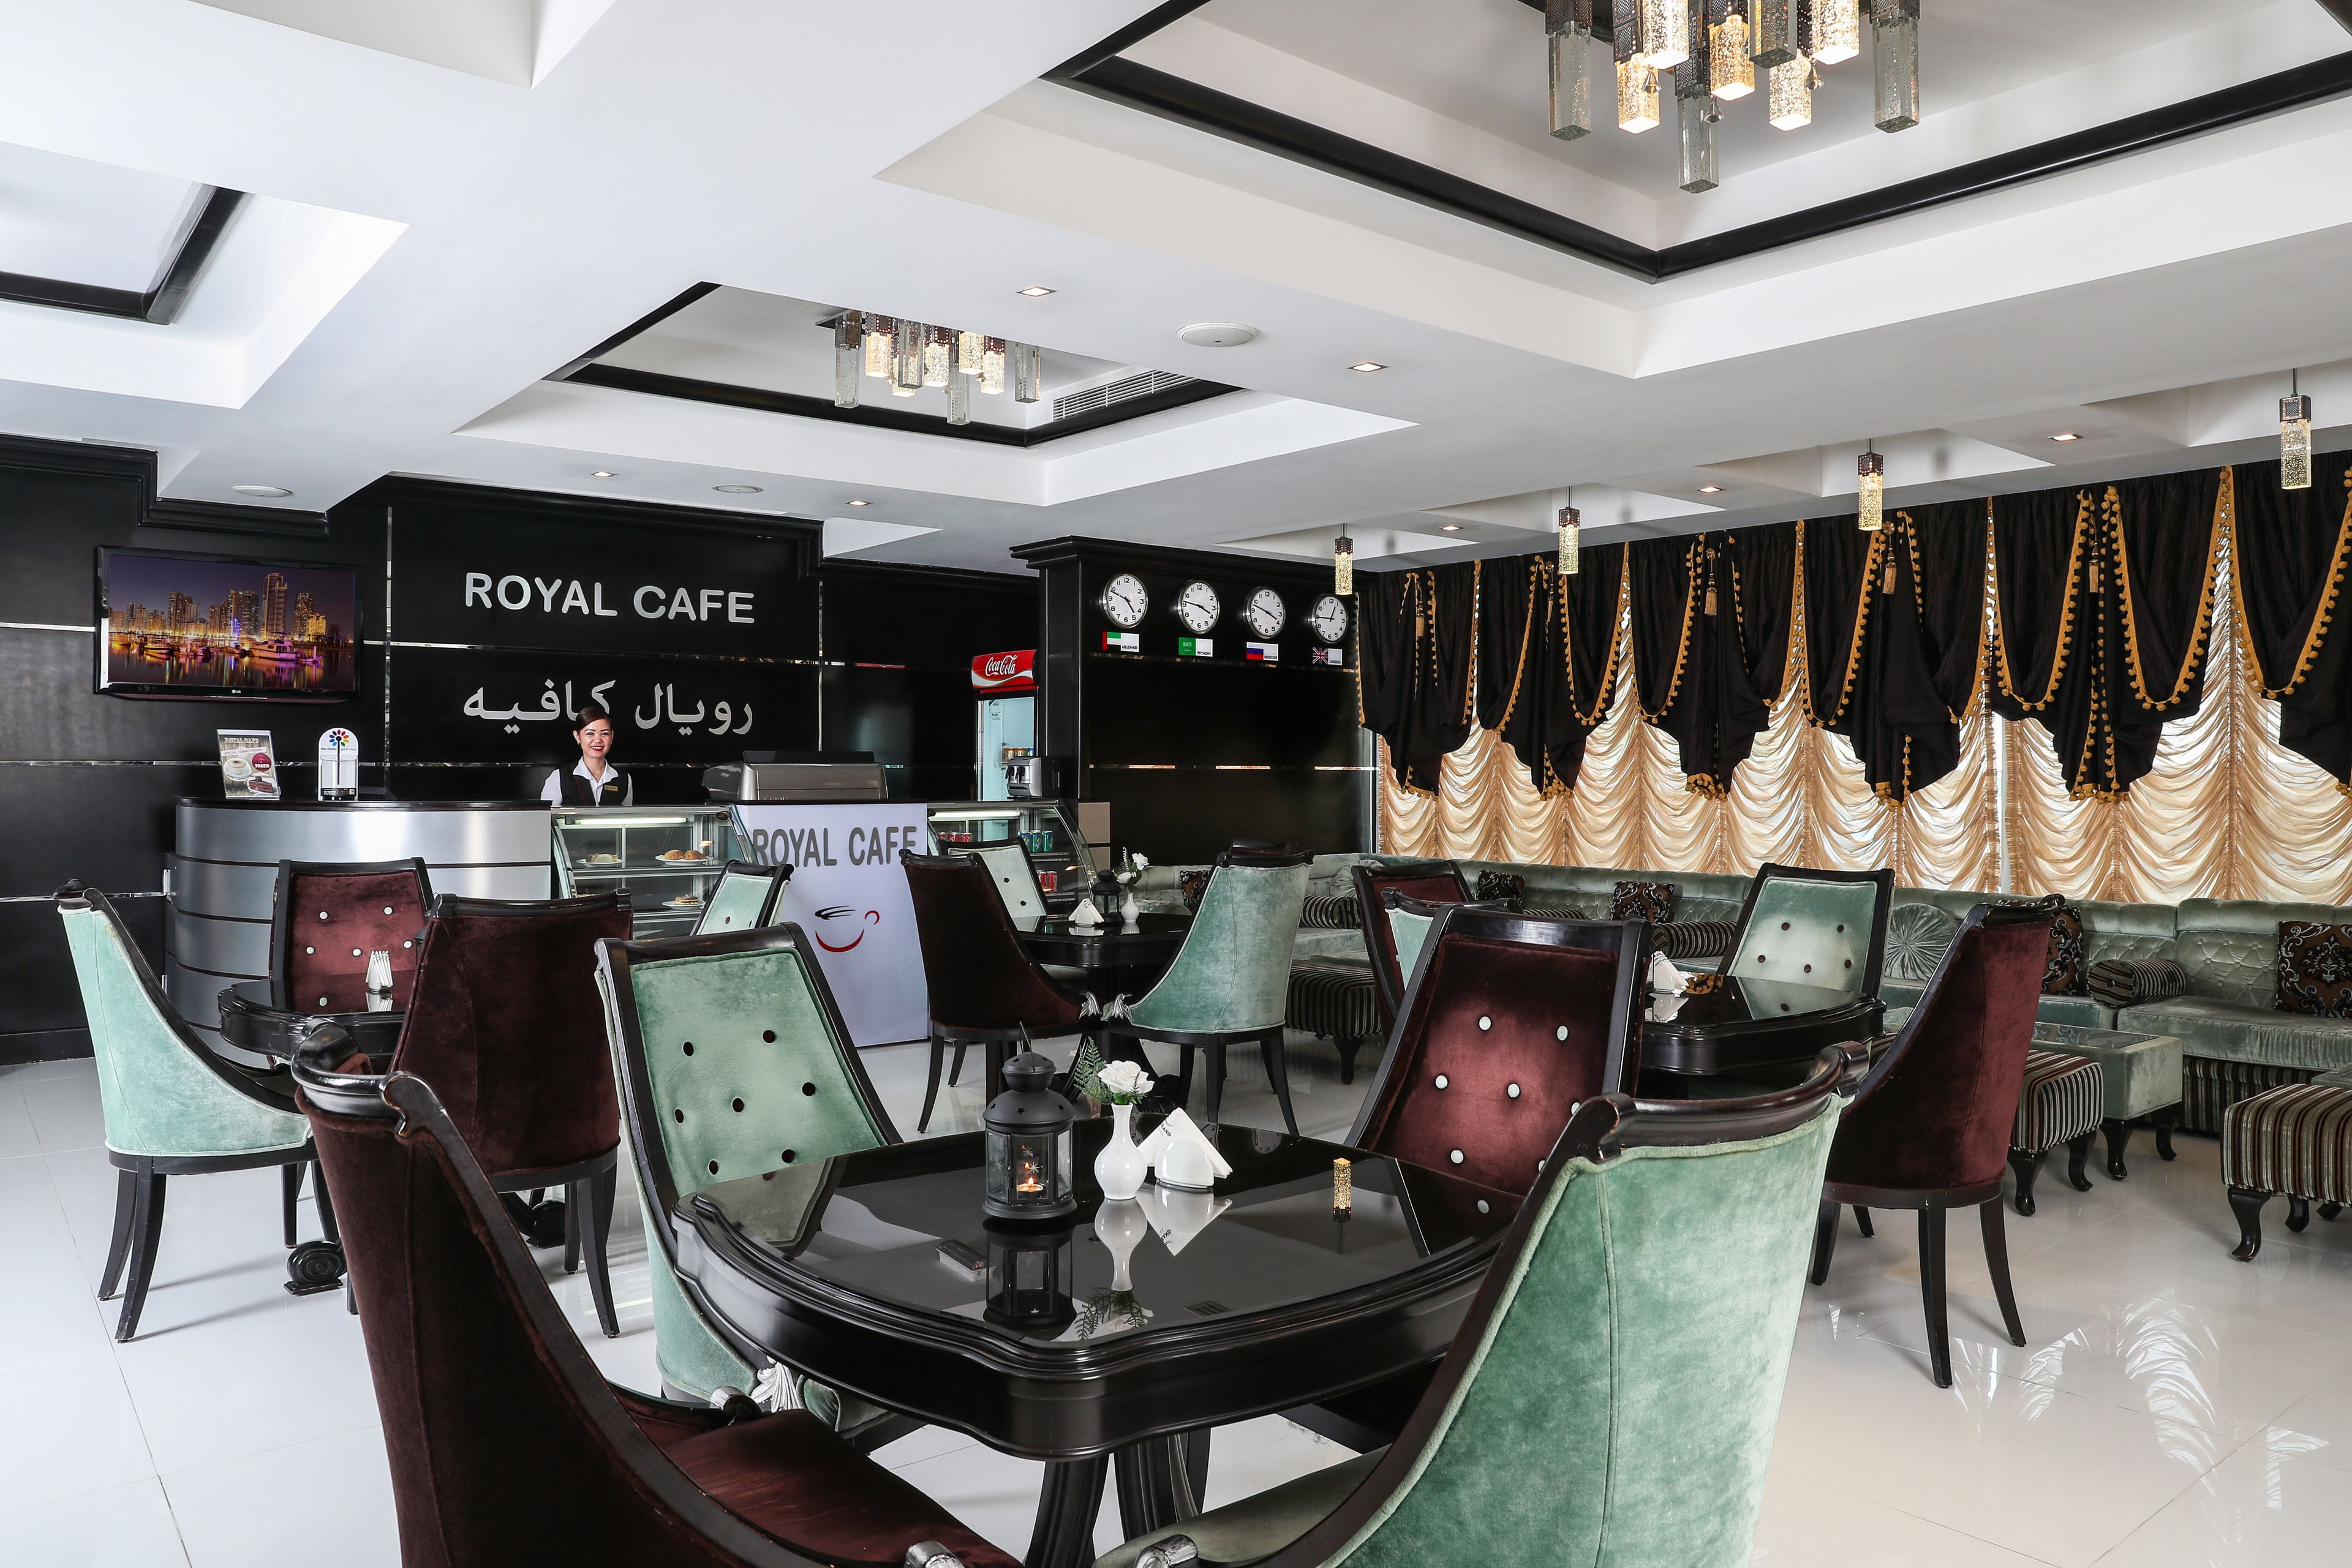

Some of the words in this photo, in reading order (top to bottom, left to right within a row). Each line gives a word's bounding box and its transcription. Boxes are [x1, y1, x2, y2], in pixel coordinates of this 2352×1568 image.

[466, 572, 617, 616] ROYAL
[633, 586, 755, 624] CAFE
[985, 654, 1019, 676] Coca-Cola
[464, 679, 616, 734] كافيه
[635, 683, 753, 735] رويال
[753, 827, 837, 867] ROYAL
[849, 827, 917, 866] CAFE
